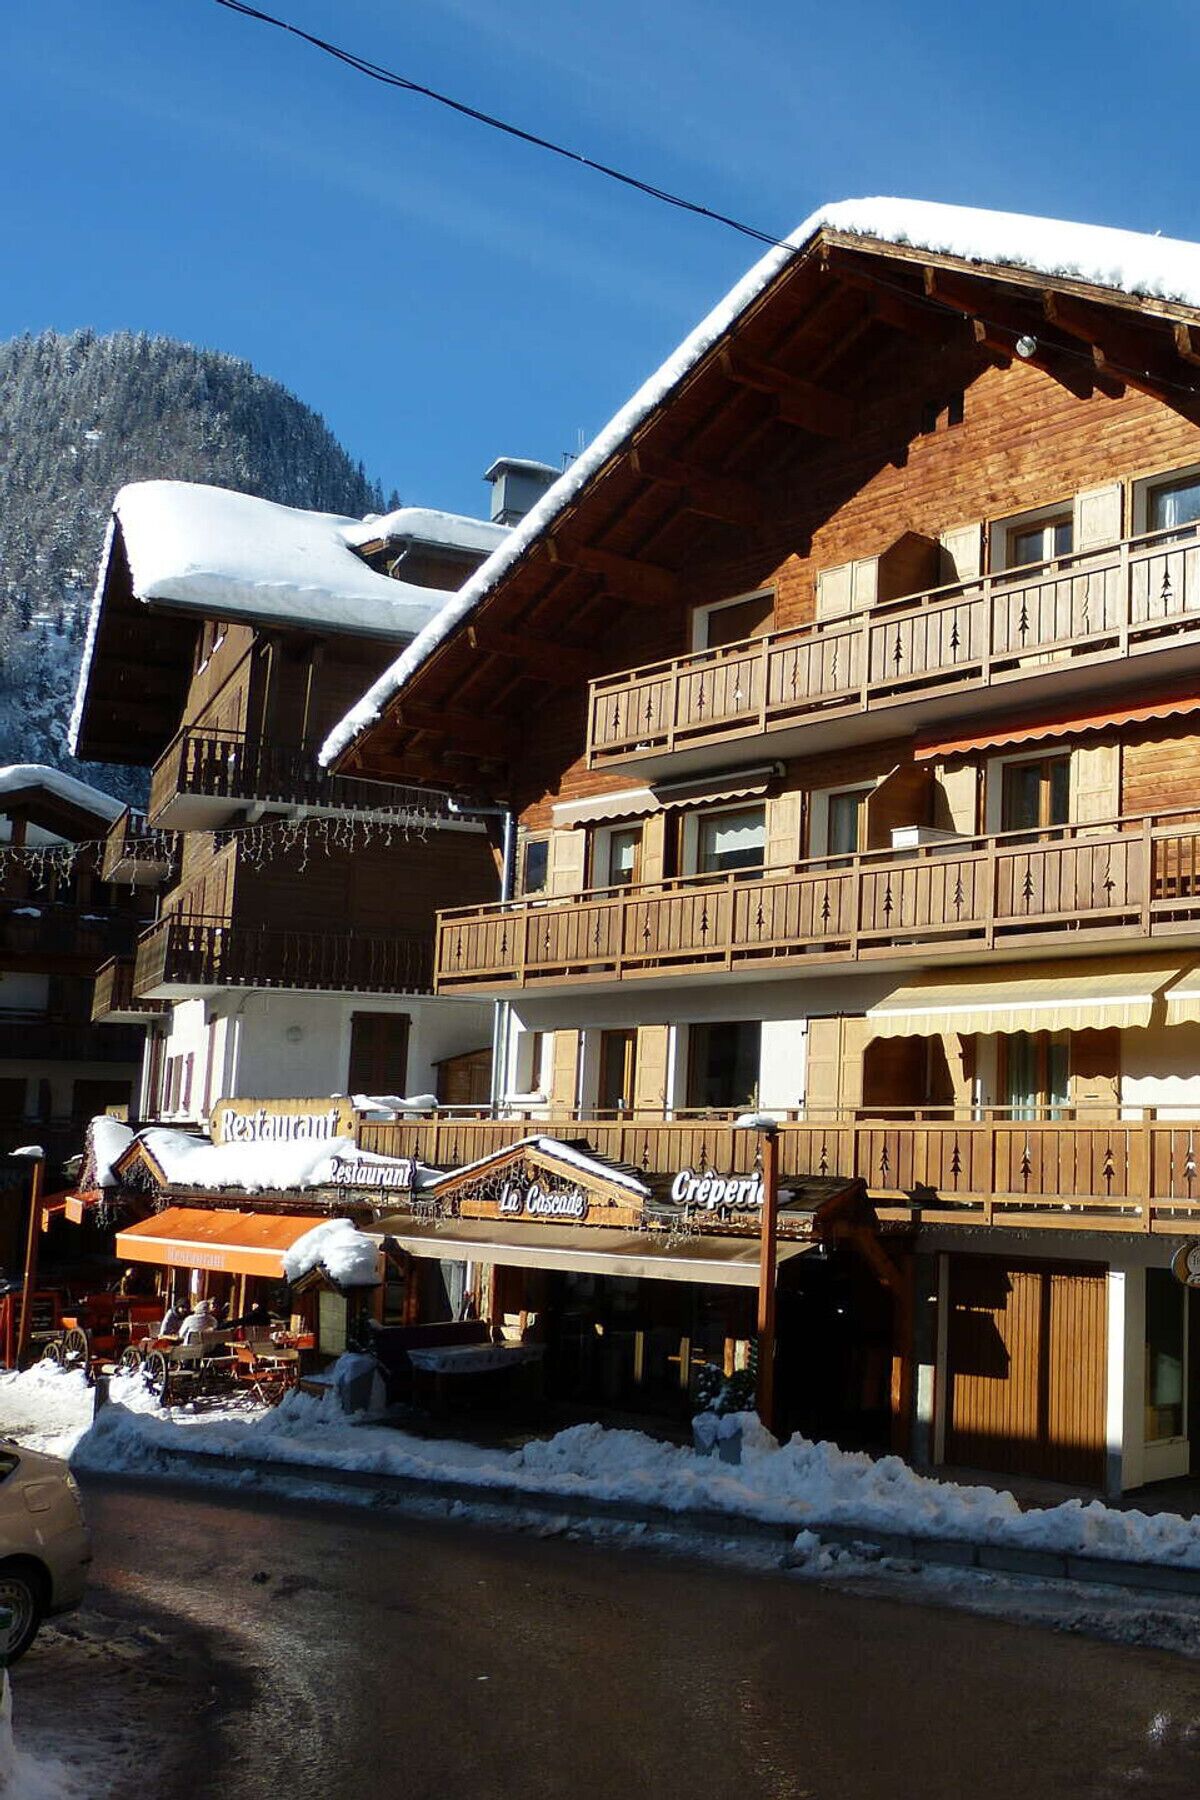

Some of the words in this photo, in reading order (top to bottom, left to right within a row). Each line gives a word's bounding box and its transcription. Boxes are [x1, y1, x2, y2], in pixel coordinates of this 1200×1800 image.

[221, 1108, 341, 1142] Restaurant
[330, 1156, 415, 1188] Restaurant
[500, 1183, 520, 1213] La
[526, 1185, 585, 1218] Cascade
